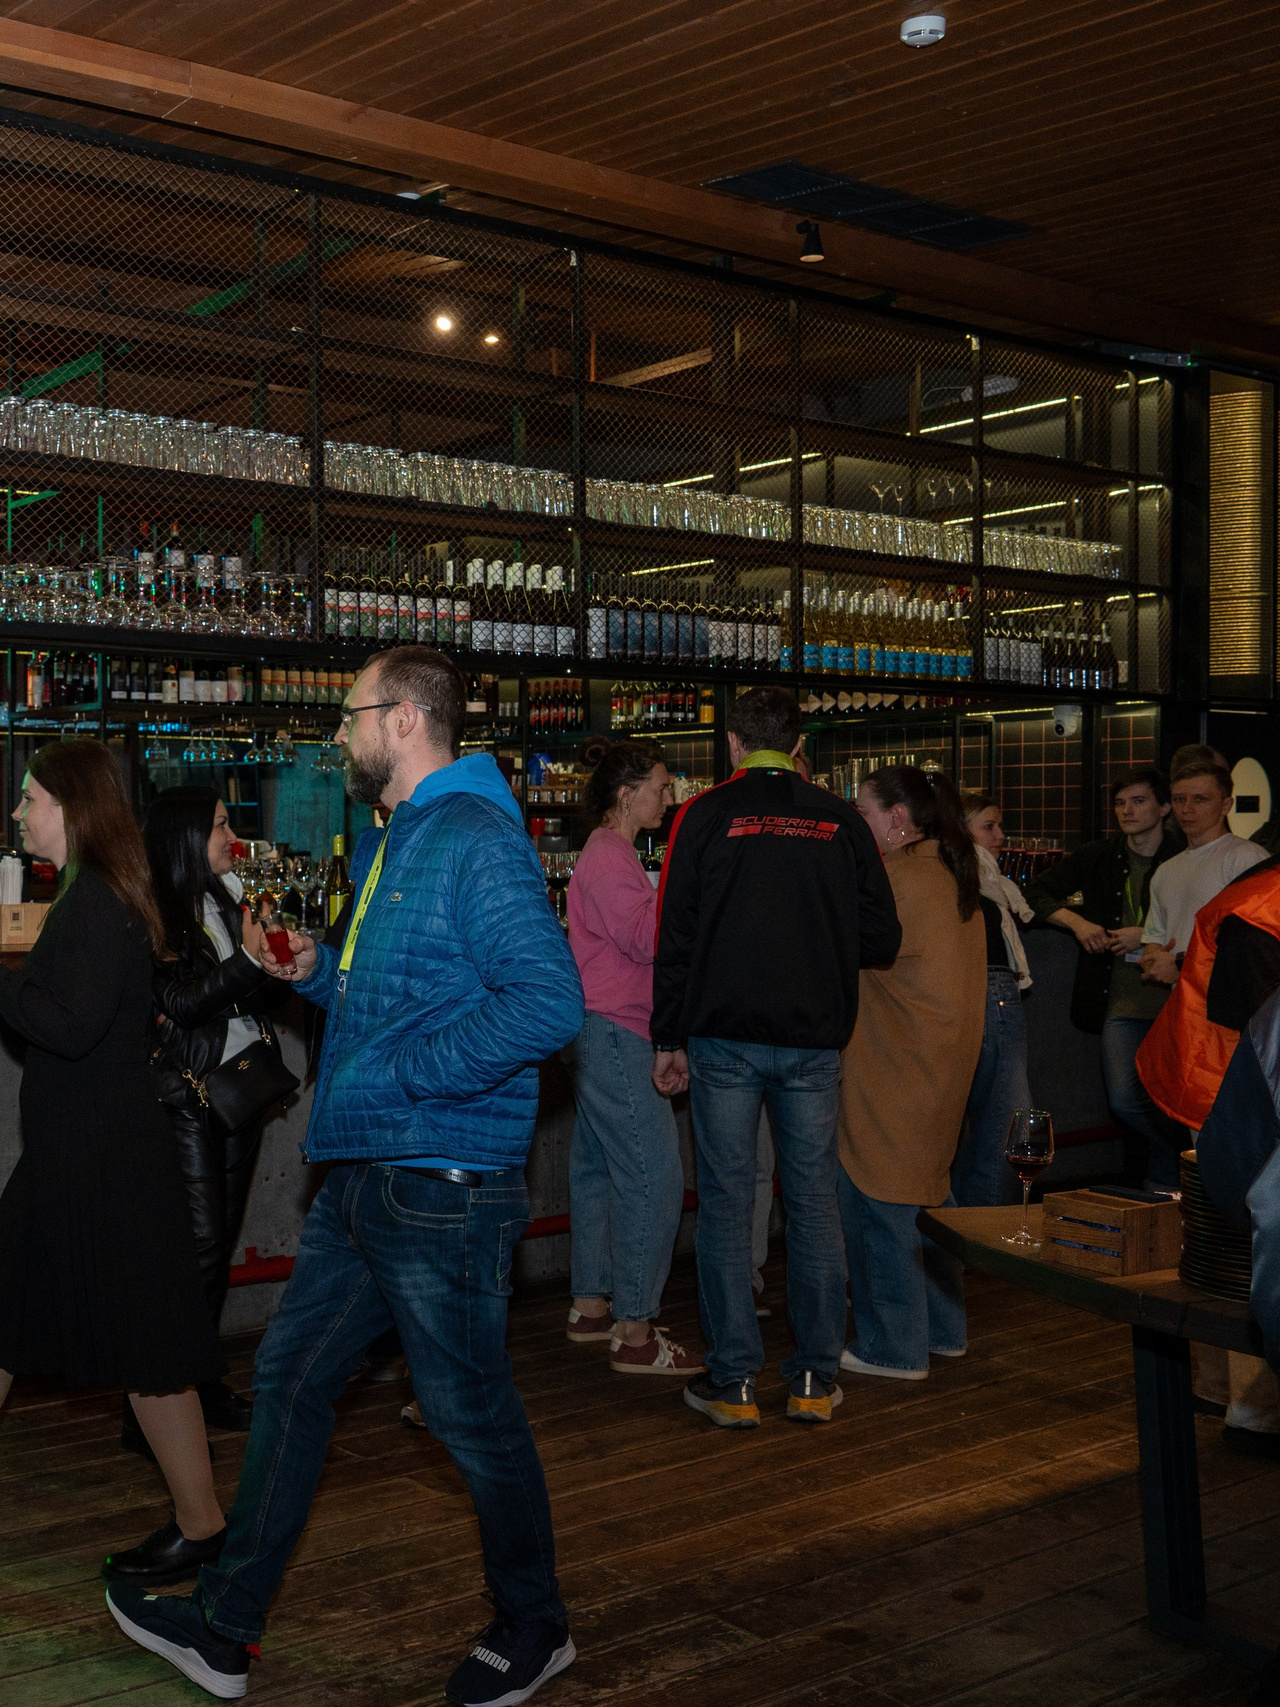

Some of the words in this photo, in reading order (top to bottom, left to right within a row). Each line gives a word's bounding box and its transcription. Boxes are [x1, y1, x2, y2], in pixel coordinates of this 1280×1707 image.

[730, 815, 816, 829] SCUDERIA
[762, 825, 835, 842] FERRARI
[470, 1645, 511, 1673] PUMA
